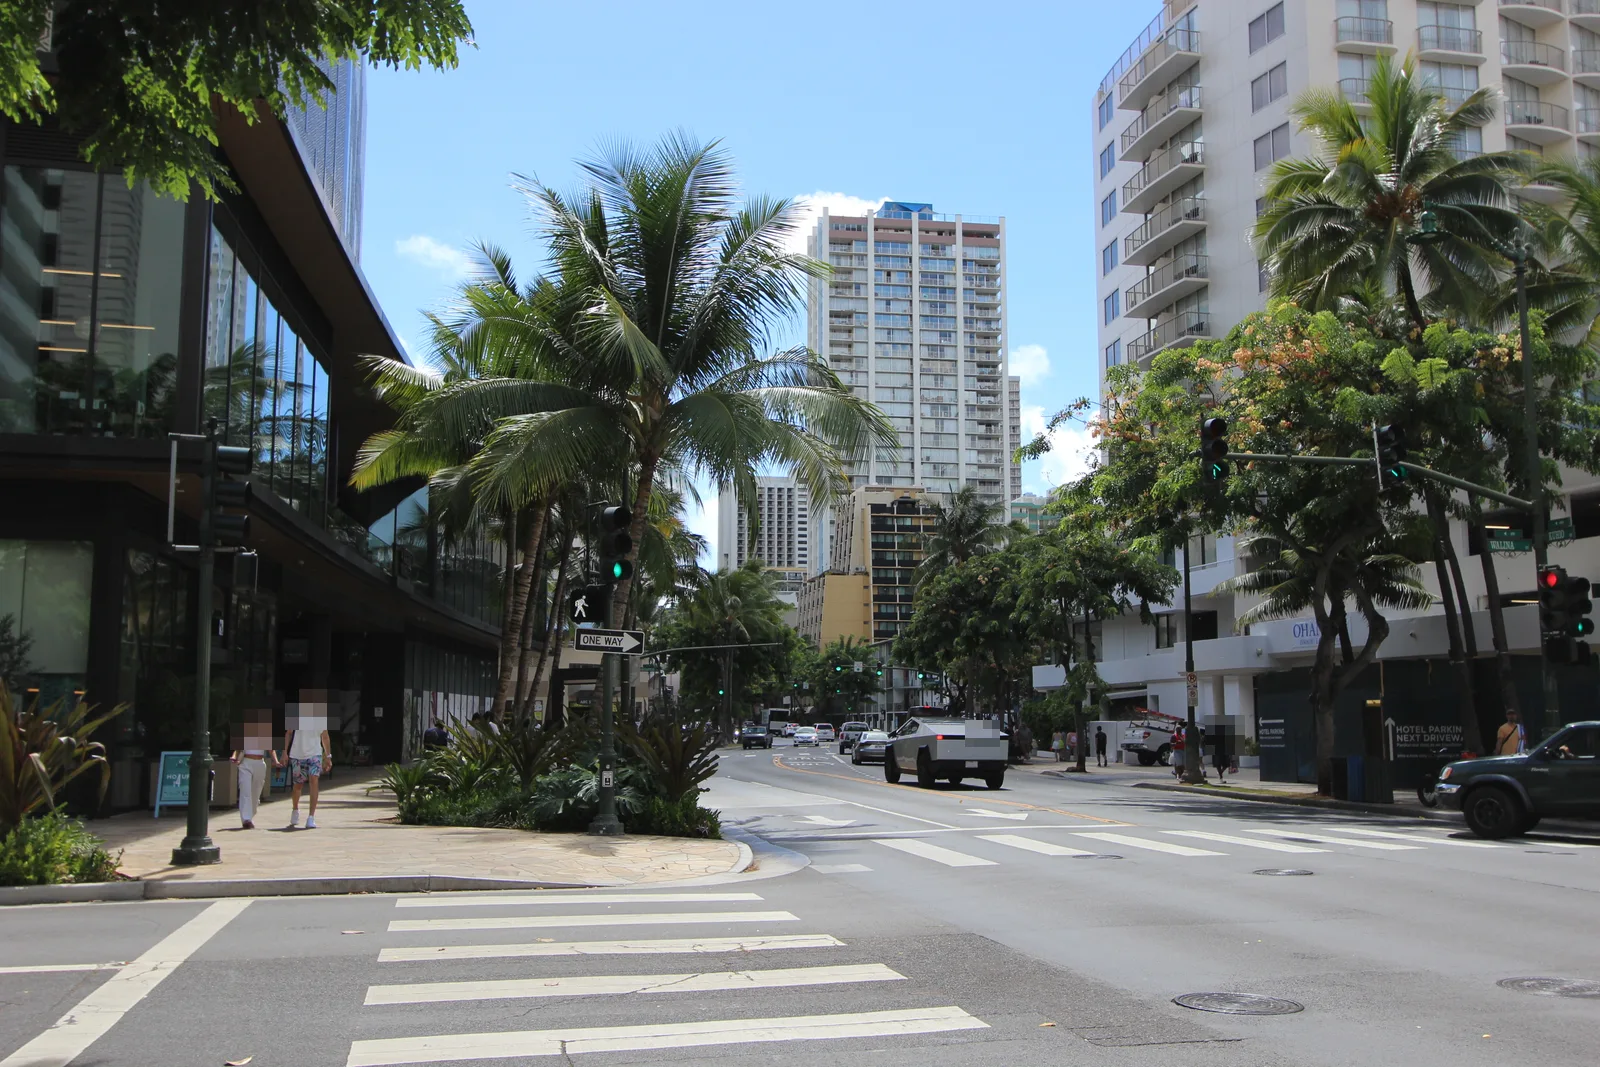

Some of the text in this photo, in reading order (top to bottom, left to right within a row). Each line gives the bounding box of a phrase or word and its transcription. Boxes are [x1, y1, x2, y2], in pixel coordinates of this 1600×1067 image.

[1490, 541, 1515, 550] WALINA
[1293, 623, 1319, 638] OHA
[582, 635, 624, 646] ONE WAY
[1396, 725, 1462, 733] HOTEL PARKIN
[1396, 734, 1420, 742] NEXT
